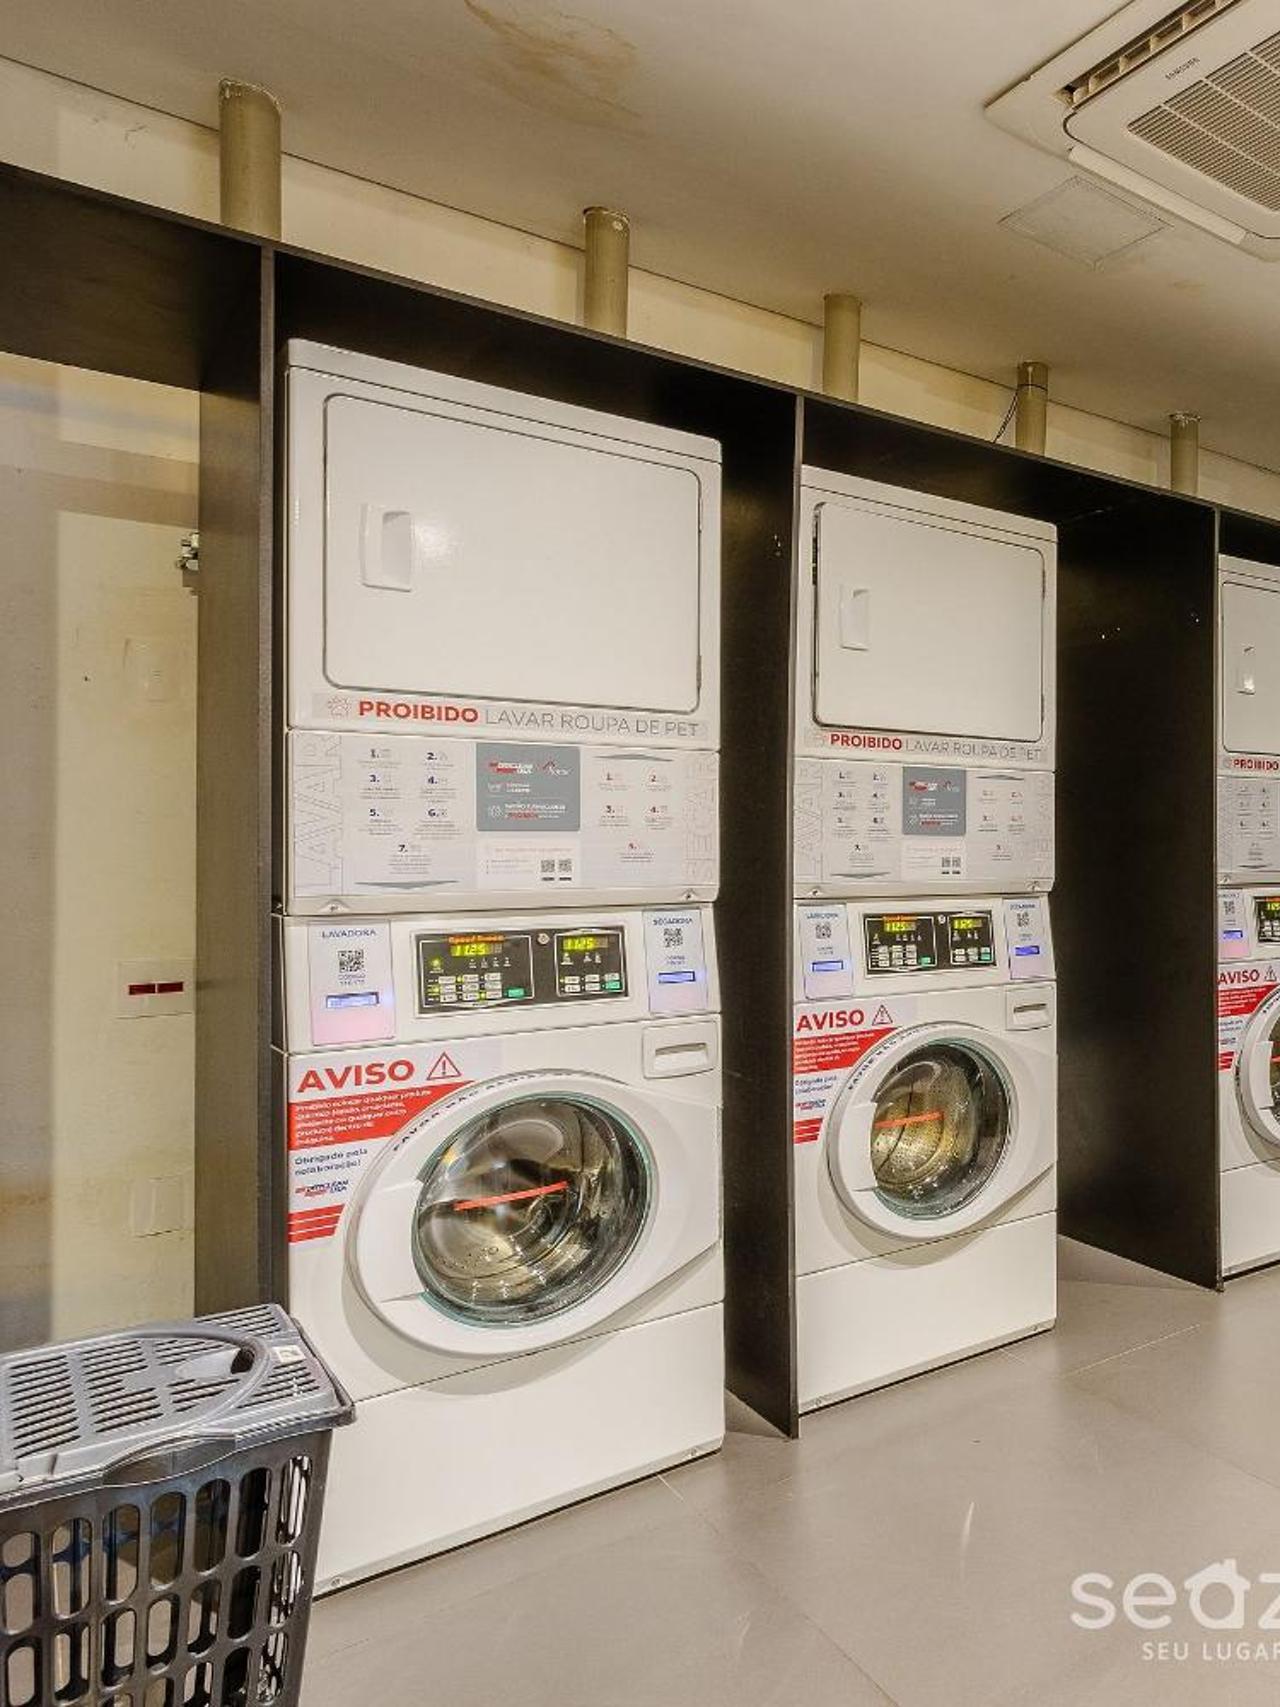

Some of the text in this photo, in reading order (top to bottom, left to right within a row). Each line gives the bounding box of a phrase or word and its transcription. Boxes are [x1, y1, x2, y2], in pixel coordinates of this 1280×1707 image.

[359, 700, 699, 737] PROIBIDO LAVAR ROUPA DE PET
[831, 733, 903, 750] PROIBIDO
[905, 739, 949, 752] LAVAR
[954, 743, 998, 757] ROUPA
[1217, 968, 1260, 985] AVISO
[796, 1009, 865, 1032] AVISO
[297, 1060, 415, 1093] AVISO
